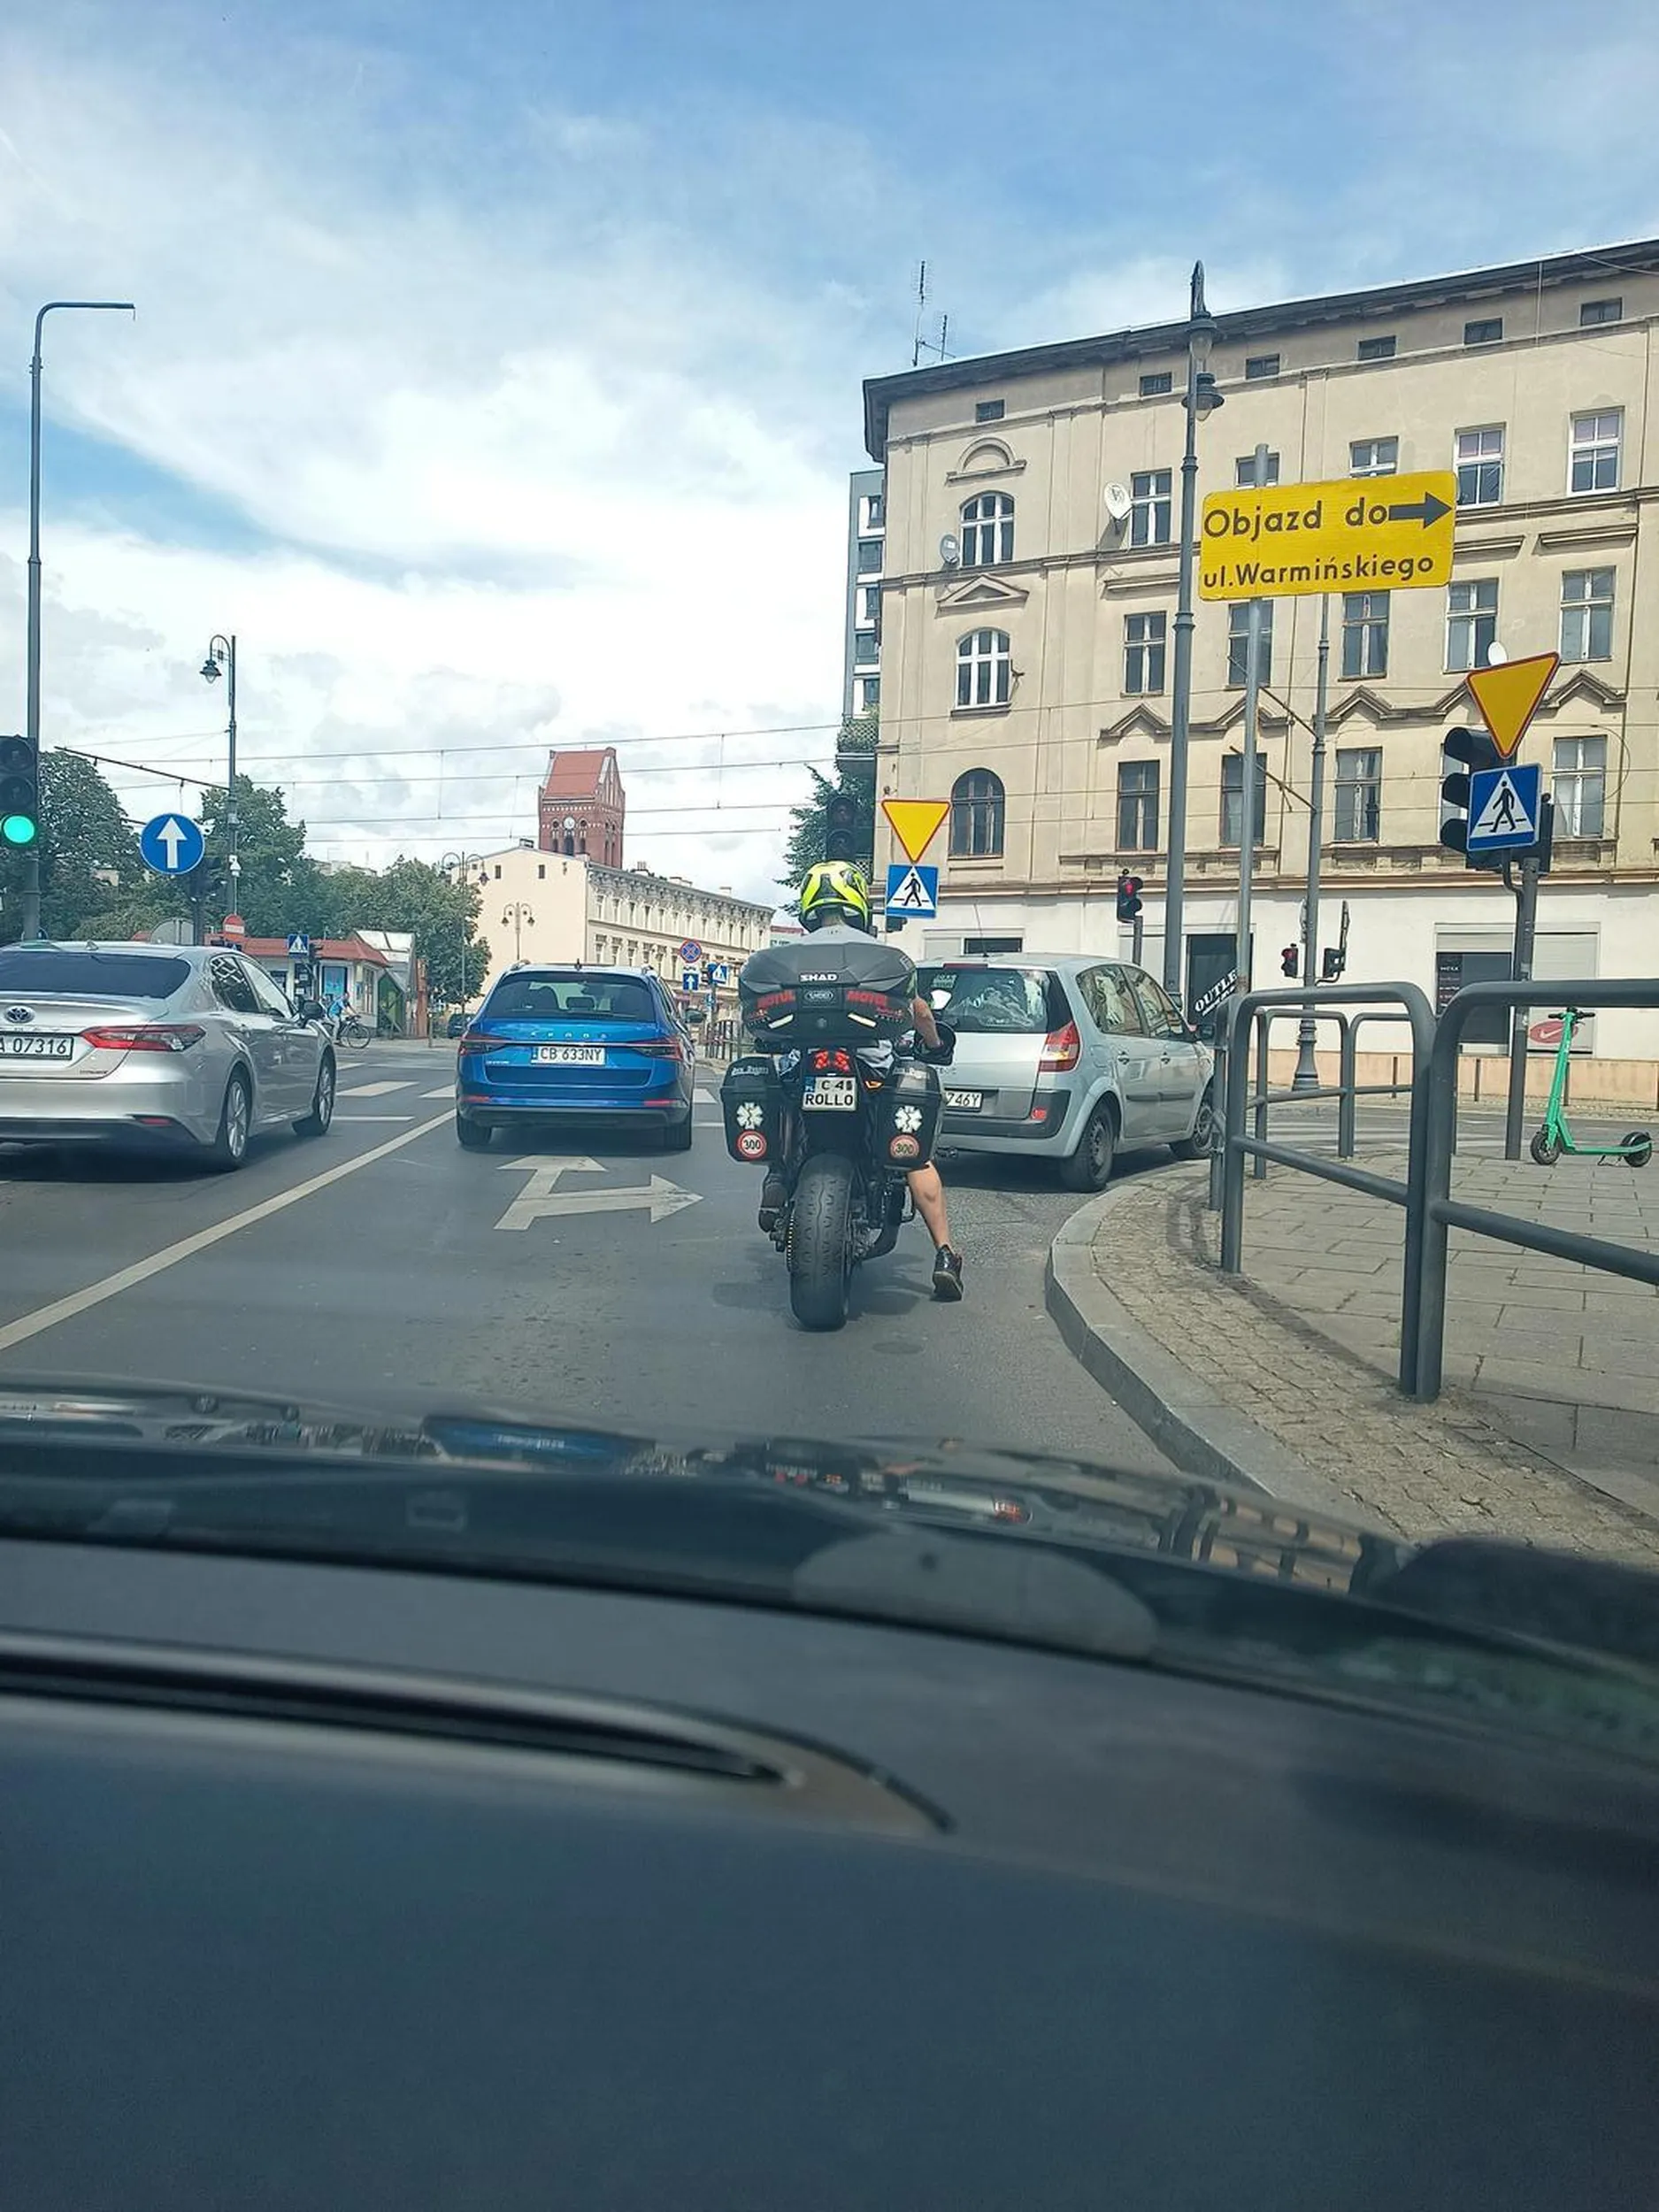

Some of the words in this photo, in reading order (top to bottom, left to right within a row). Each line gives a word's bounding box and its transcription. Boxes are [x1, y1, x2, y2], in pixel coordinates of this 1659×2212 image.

[1203, 499, 1322, 541] Objazd
[1345, 496, 1388, 526] do
[1195, 969, 1238, 1011] OUTLE
[12, 1038, 67, 1054] 07316
[540, 1048, 557, 1059] CB
[562, 1048, 602, 1061] 633NY
[805, 1094, 853, 1106] ROLLO
[743, 1139, 761, 1150] 300
